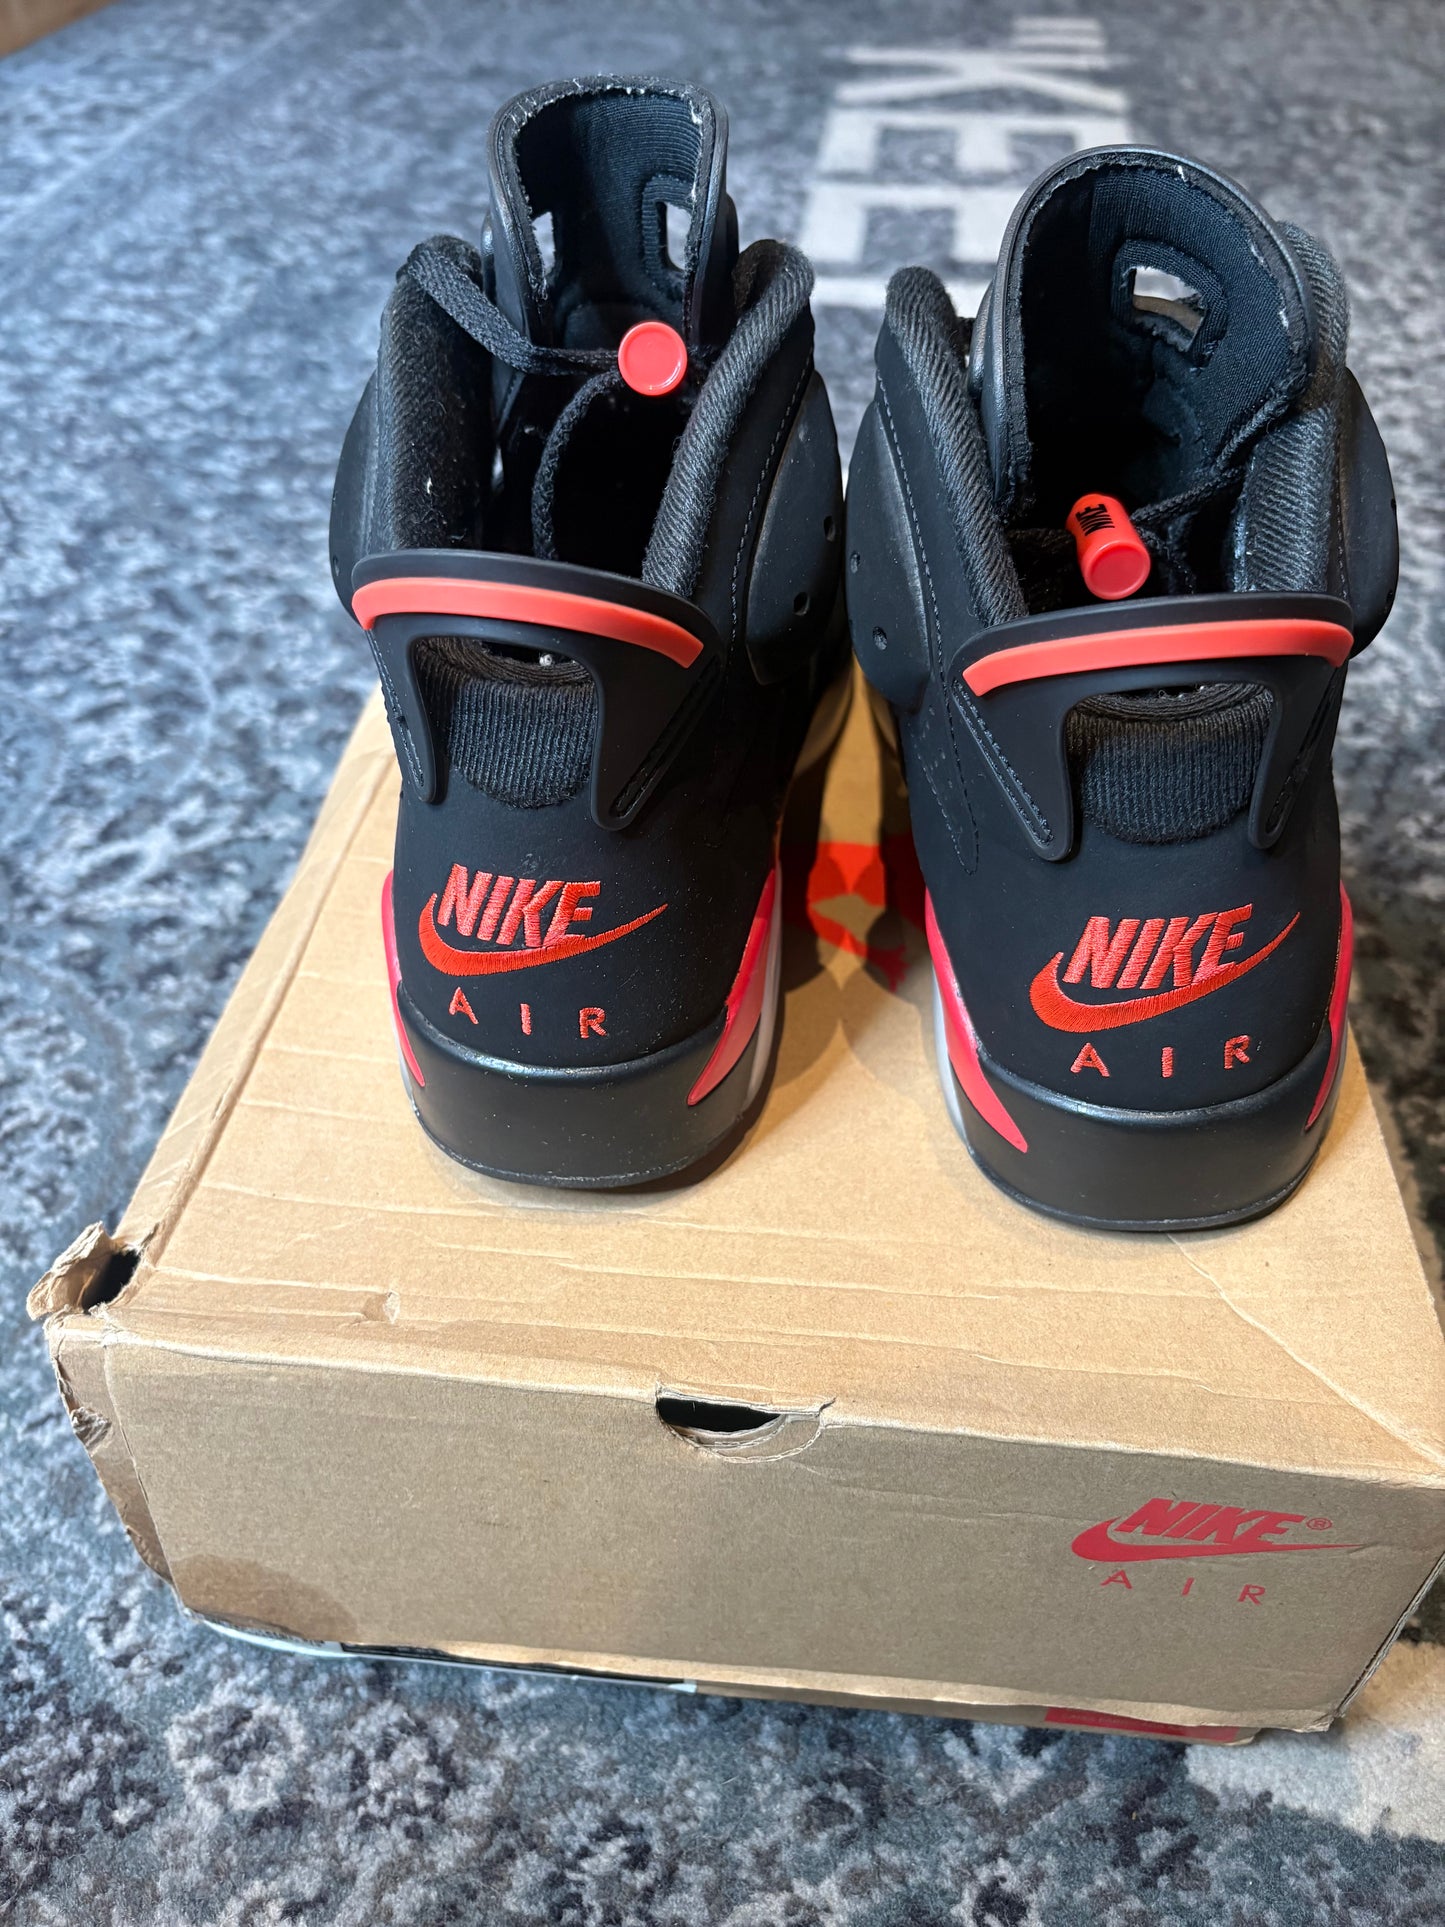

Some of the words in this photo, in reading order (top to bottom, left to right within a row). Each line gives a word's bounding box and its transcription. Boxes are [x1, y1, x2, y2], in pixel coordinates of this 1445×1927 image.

[1075, 503, 1116, 536] NIKE
[437, 863, 601, 947] NIKE
[1061, 903, 1252, 990] NIKE
[449, 987, 608, 1038] AIR
[1070, 1035, 1251, 1078] AIR
[1101, 1569, 1266, 1606] AIR
